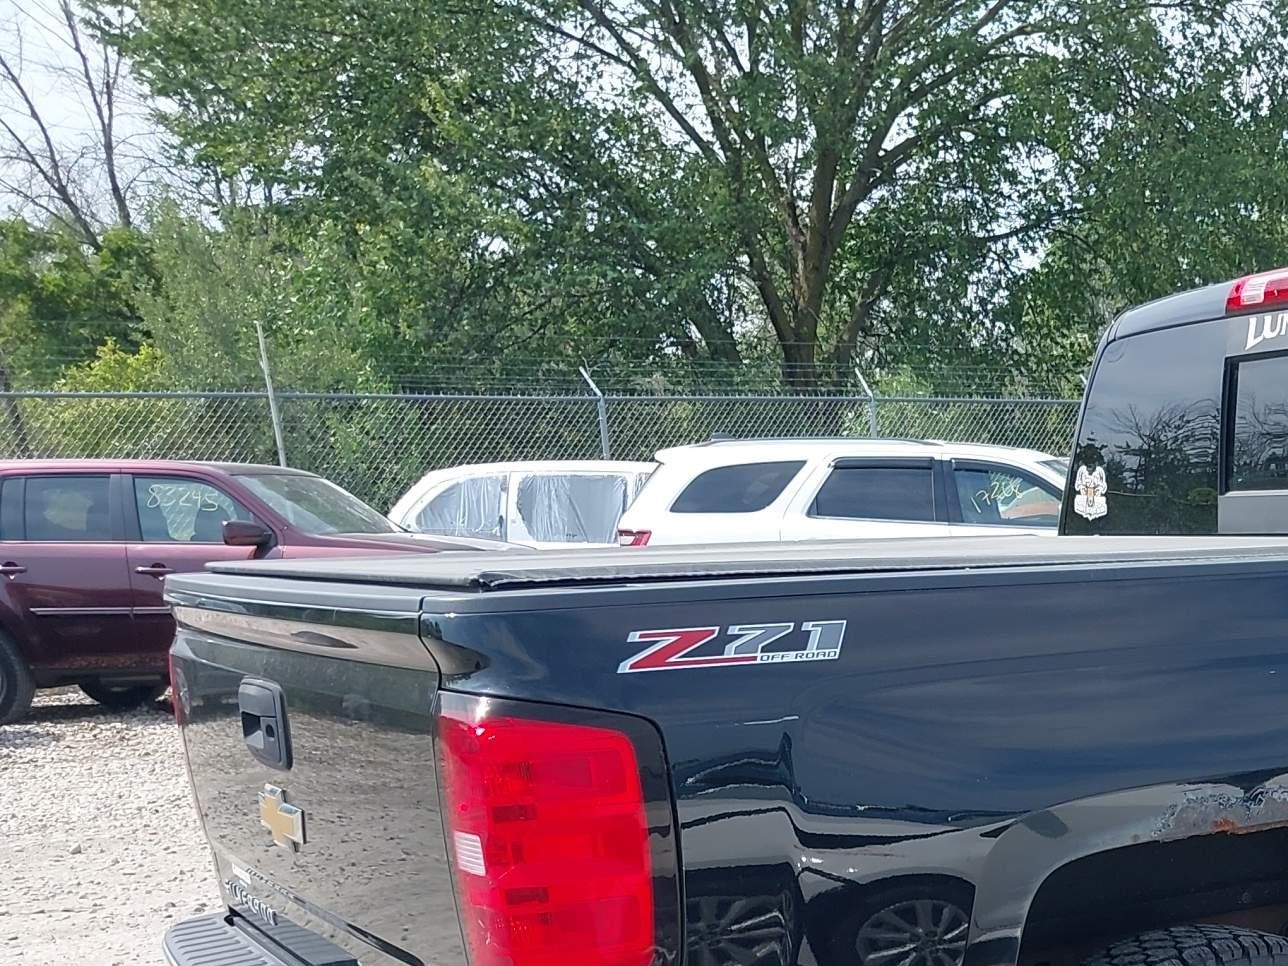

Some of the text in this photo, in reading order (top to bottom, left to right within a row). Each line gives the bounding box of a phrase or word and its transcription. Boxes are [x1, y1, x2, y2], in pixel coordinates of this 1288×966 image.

[146, 484, 219, 512] 83245
[617, 620, 848, 674] Z71
[759, 650, 838, 663] OFF ROAD
